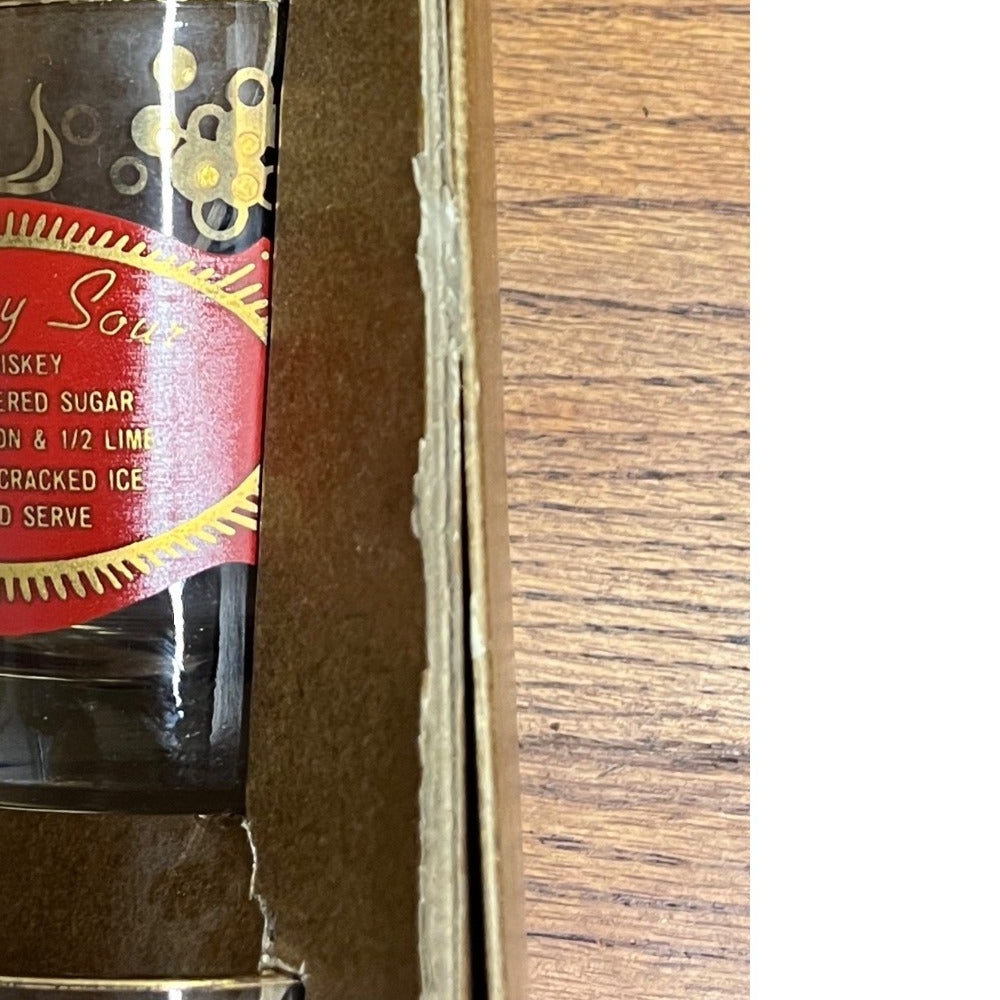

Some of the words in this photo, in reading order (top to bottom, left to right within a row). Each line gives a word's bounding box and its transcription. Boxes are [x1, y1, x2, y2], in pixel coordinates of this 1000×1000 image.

[60, 389, 135, 413] SUGAR
[33, 429, 47, 450] &
[61, 428, 93, 451] 1/2
[108, 467, 145, 493] ICE
[23, 505, 94, 529] SERVE
